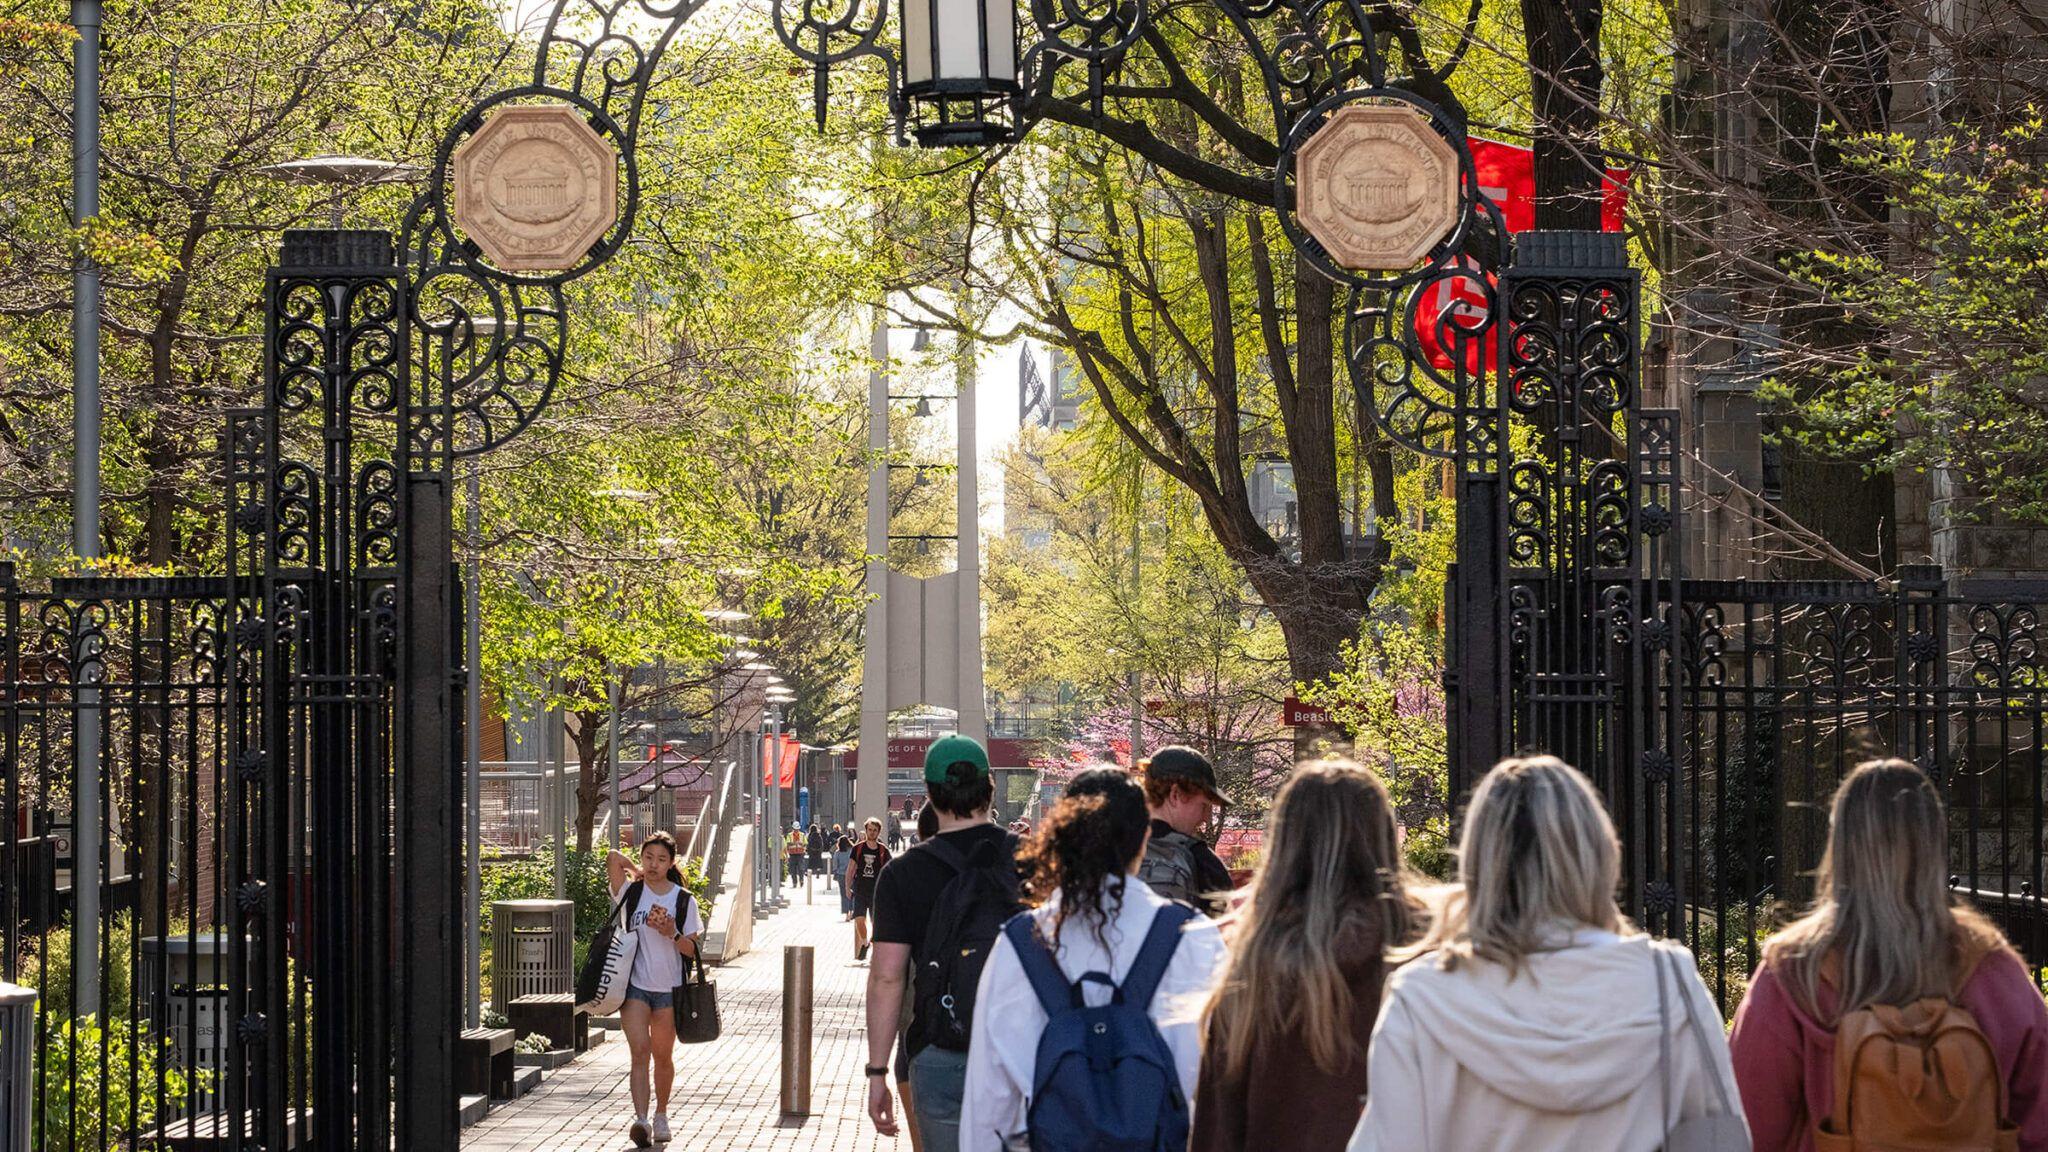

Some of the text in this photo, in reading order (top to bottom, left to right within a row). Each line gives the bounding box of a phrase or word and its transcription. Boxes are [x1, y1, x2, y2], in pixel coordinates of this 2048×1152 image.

[1294, 711, 1336, 722] Beasle
[888, 745, 928, 753] GE OF LI
